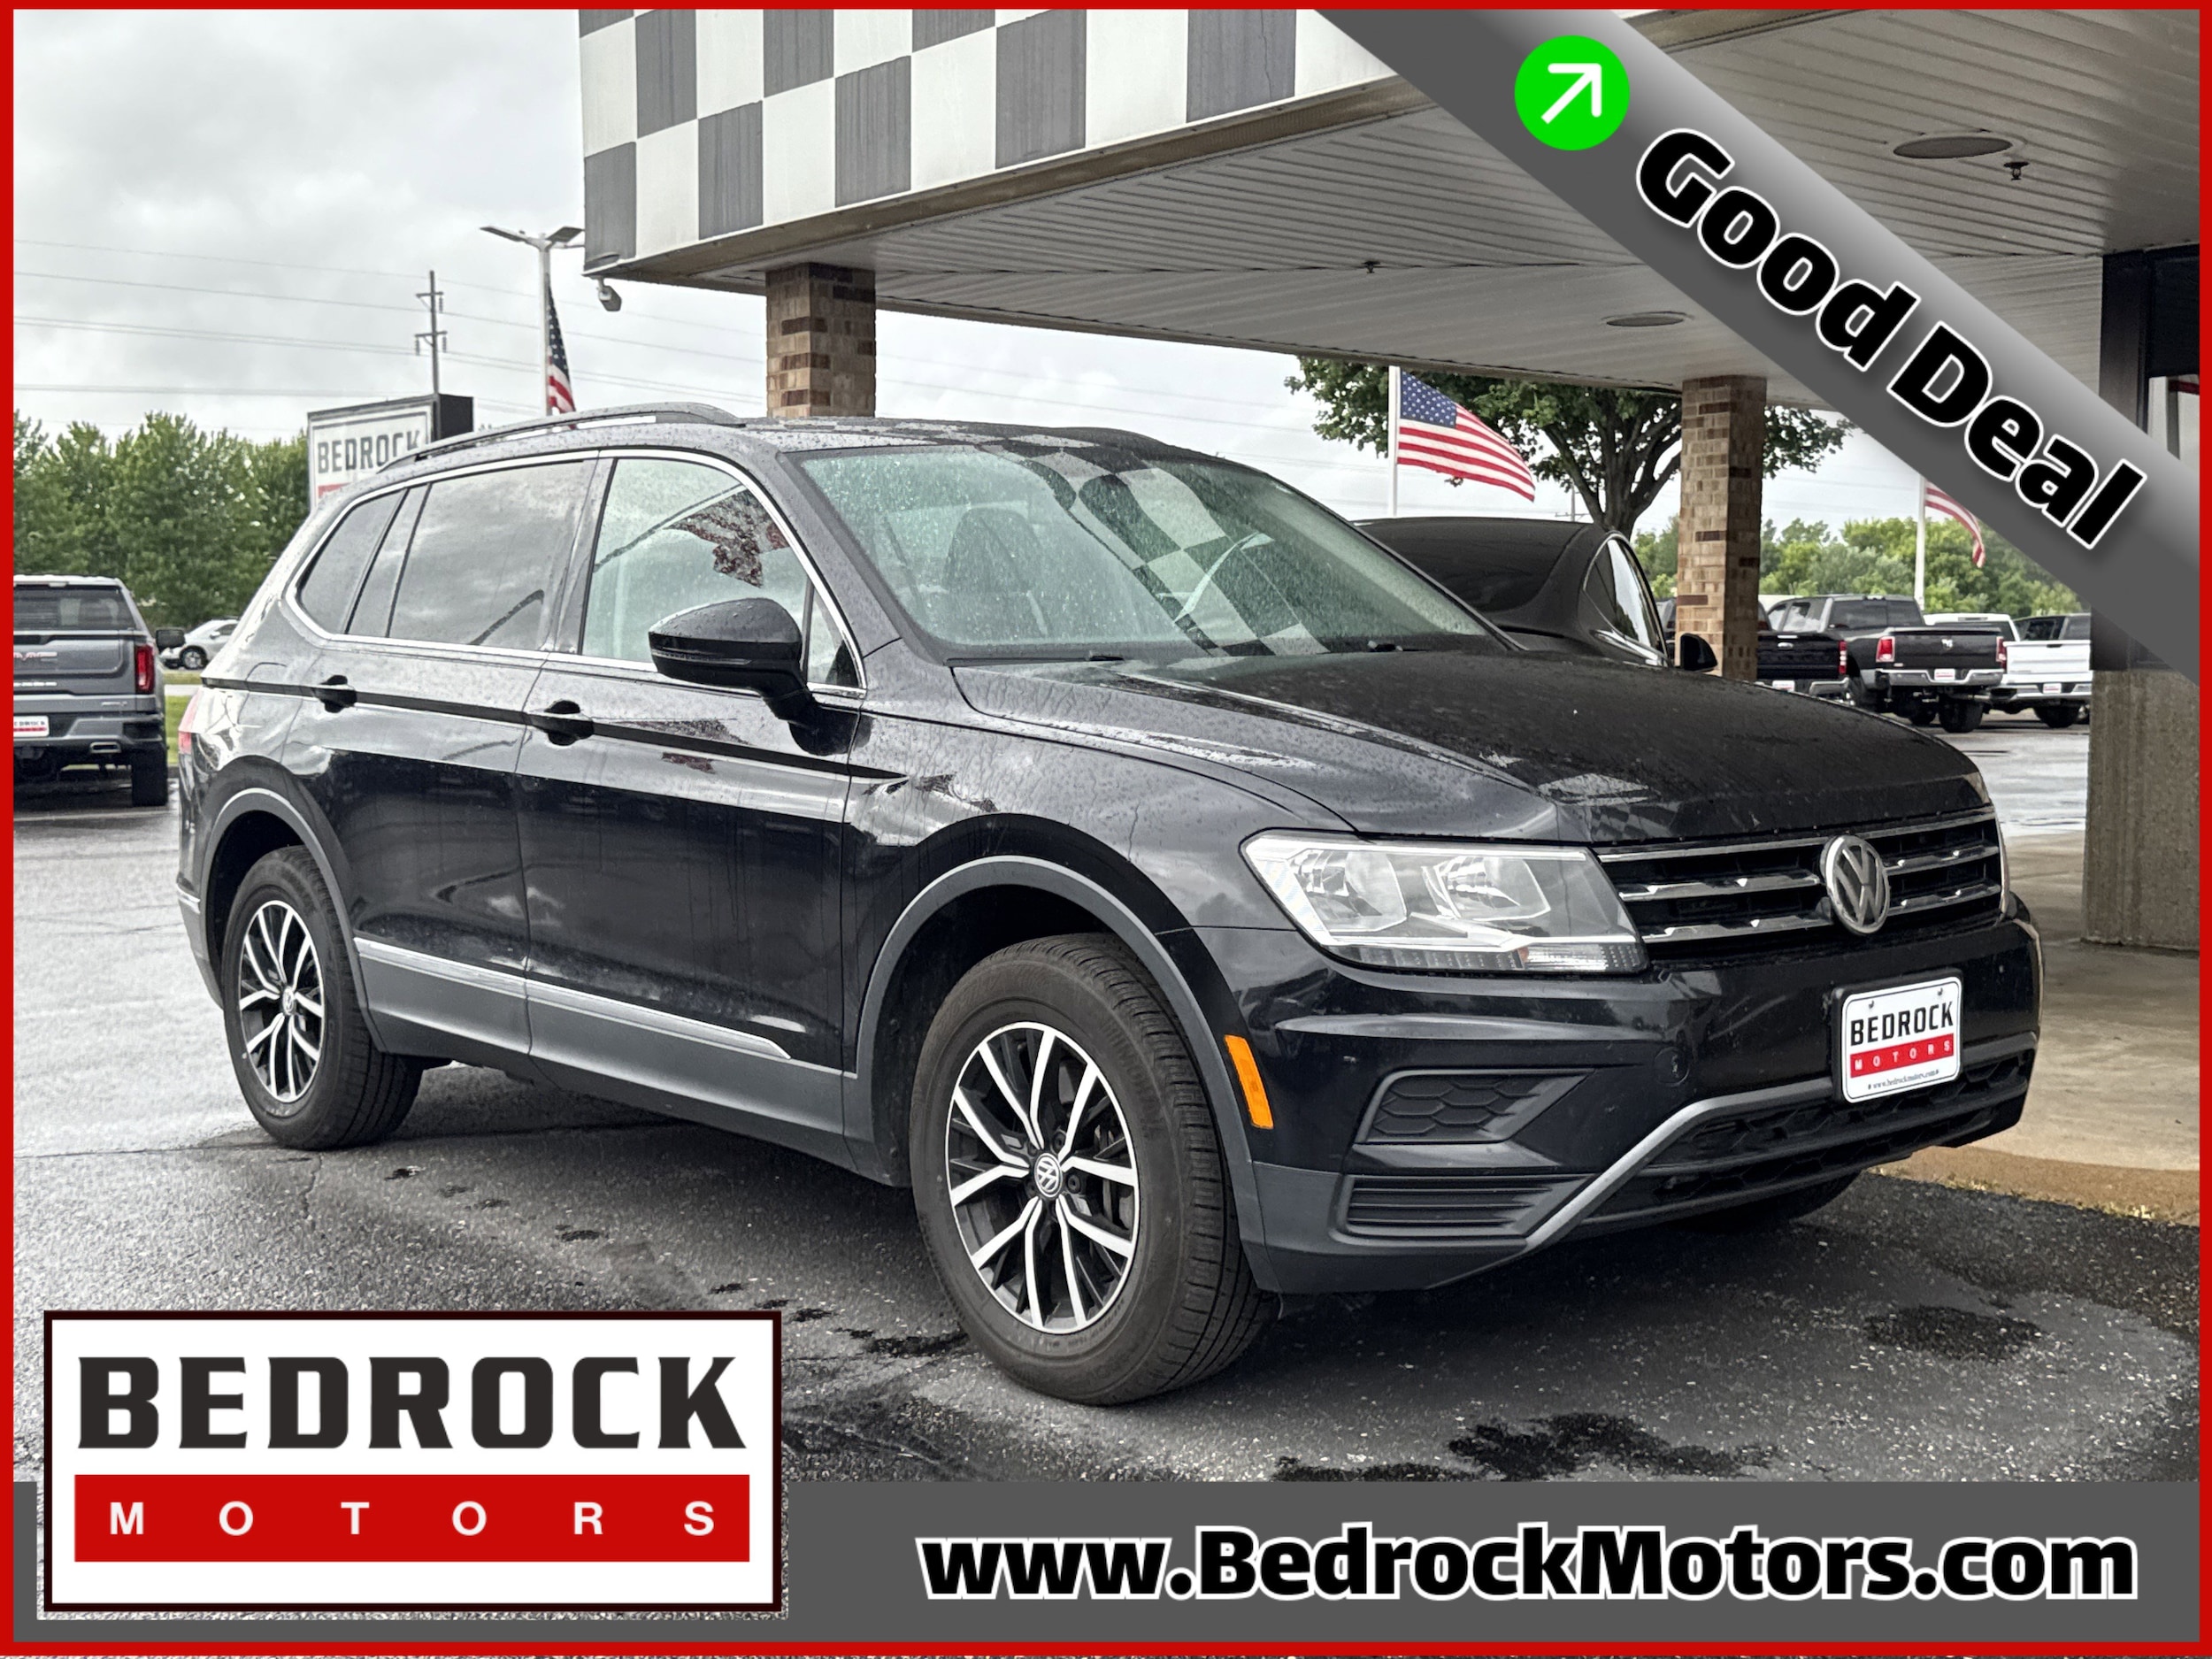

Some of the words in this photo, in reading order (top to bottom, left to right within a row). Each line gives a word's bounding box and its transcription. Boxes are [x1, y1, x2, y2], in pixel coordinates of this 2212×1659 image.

[318, 430, 420, 473] BEDROCK
[1850, 1001, 1954, 1046] BEDROCK
[1855, 1040, 1950, 1071] MOTORS
